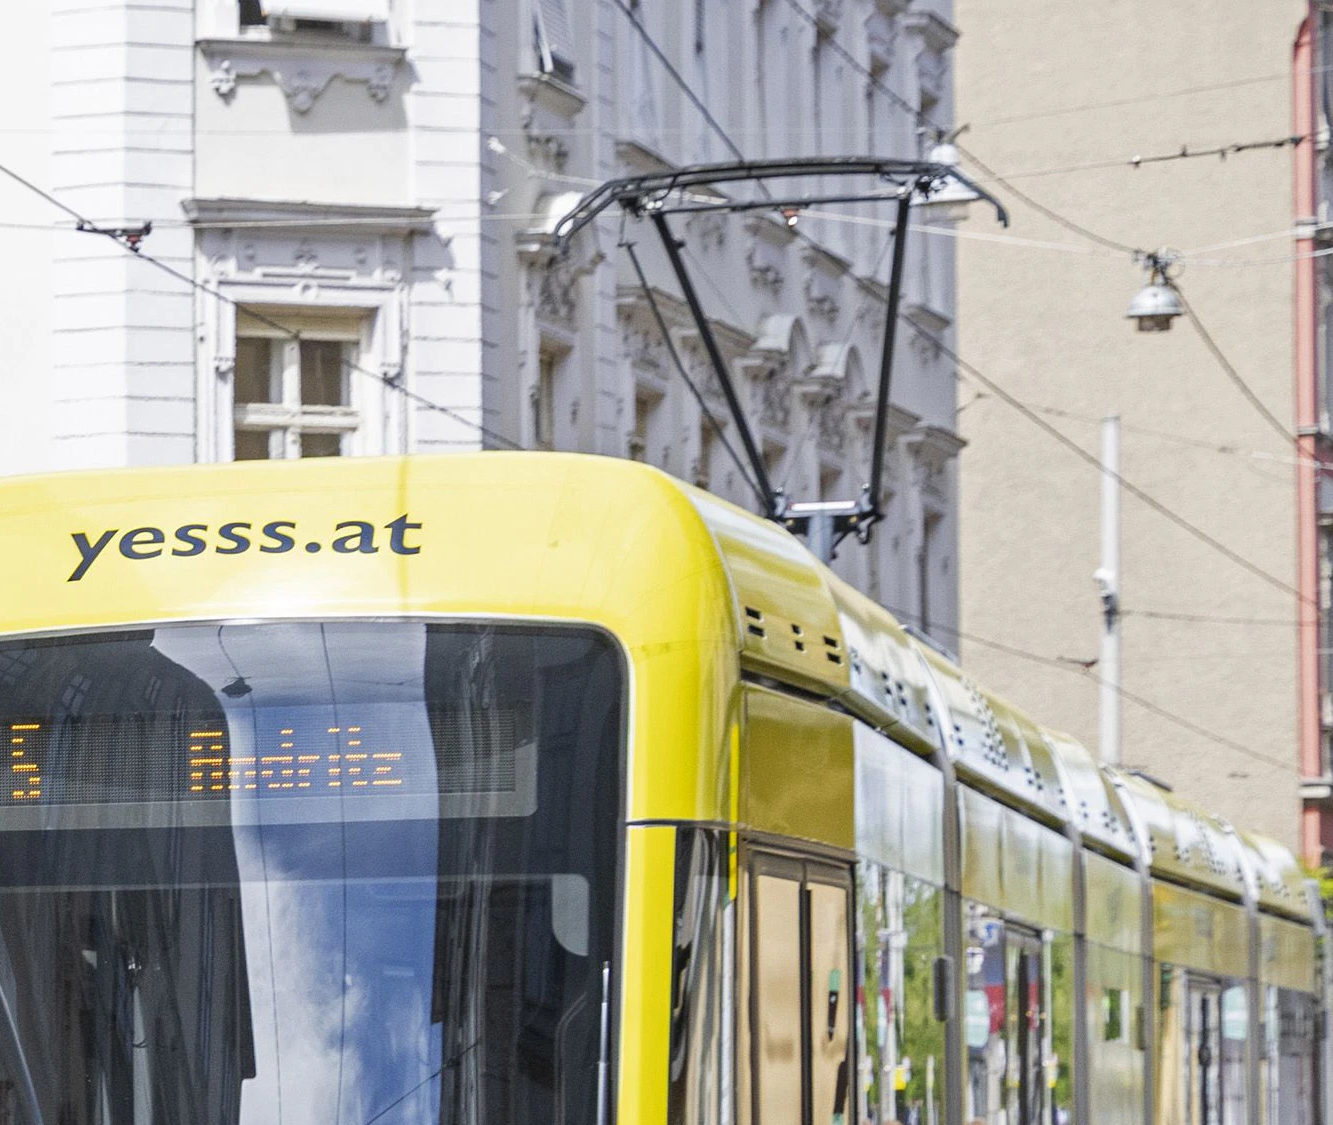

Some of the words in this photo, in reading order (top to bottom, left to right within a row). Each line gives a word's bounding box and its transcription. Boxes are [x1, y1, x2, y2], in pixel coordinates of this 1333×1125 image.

[66, 513, 423, 583] yesss.at
[11, 724, 41, 798] 5
[190, 726, 403, 791] Andritz
